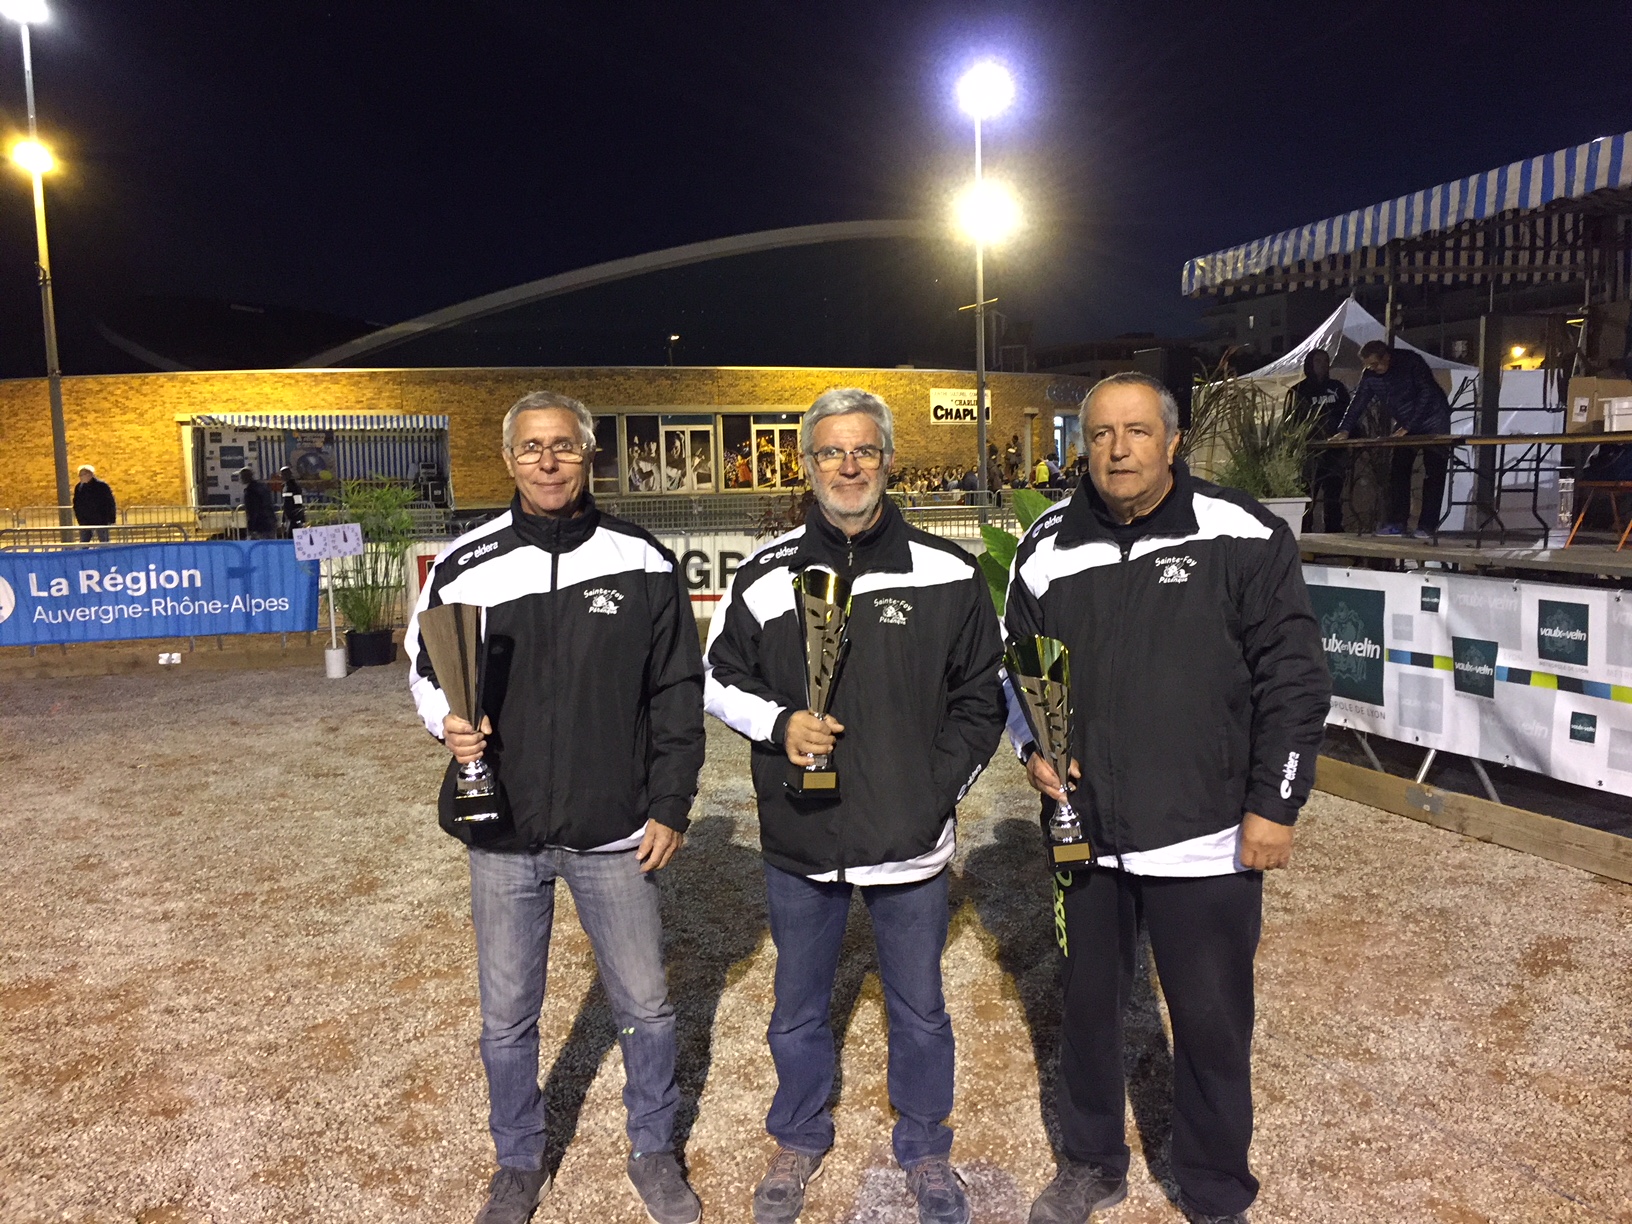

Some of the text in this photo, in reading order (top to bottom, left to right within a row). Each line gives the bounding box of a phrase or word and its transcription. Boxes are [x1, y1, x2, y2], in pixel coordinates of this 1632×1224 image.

[28, 564, 202, 598] La Région
[32, 594, 290, 624] Auvergne-Rhône-Alpes
